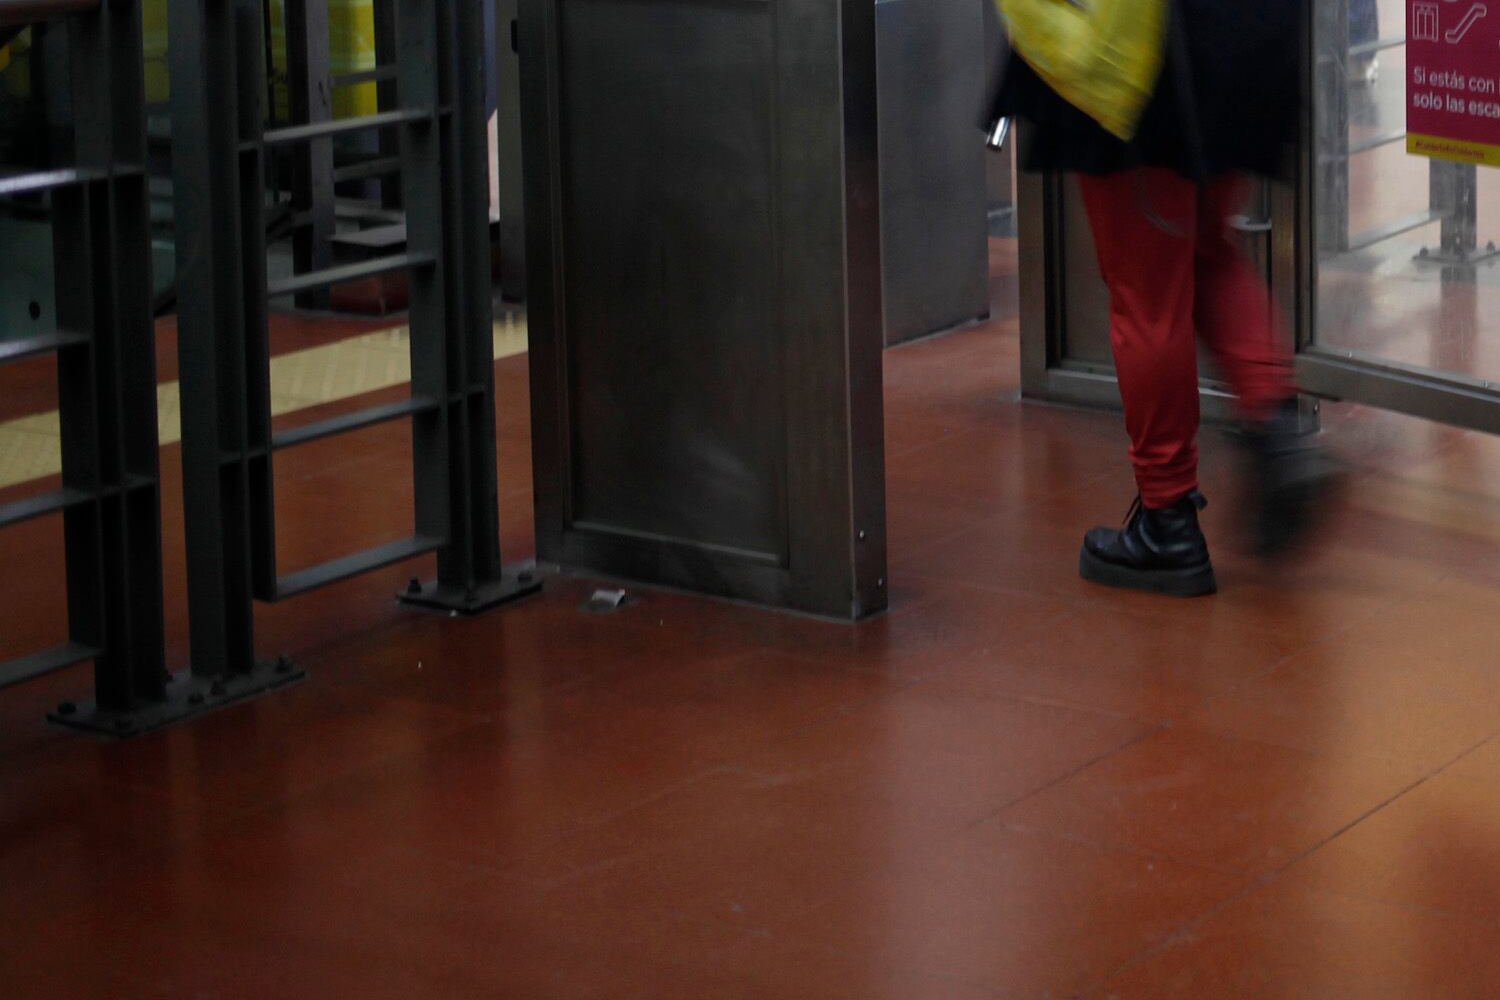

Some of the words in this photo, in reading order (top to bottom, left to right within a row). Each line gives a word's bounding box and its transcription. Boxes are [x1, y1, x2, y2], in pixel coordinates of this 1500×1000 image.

[1413, 67, 1426, 84] Si
[1429, 69, 1465, 90] estás
[1468, 77, 1495, 93] con
[1413, 92, 1442, 110] solo
[1446, 95, 1465, 113] las
